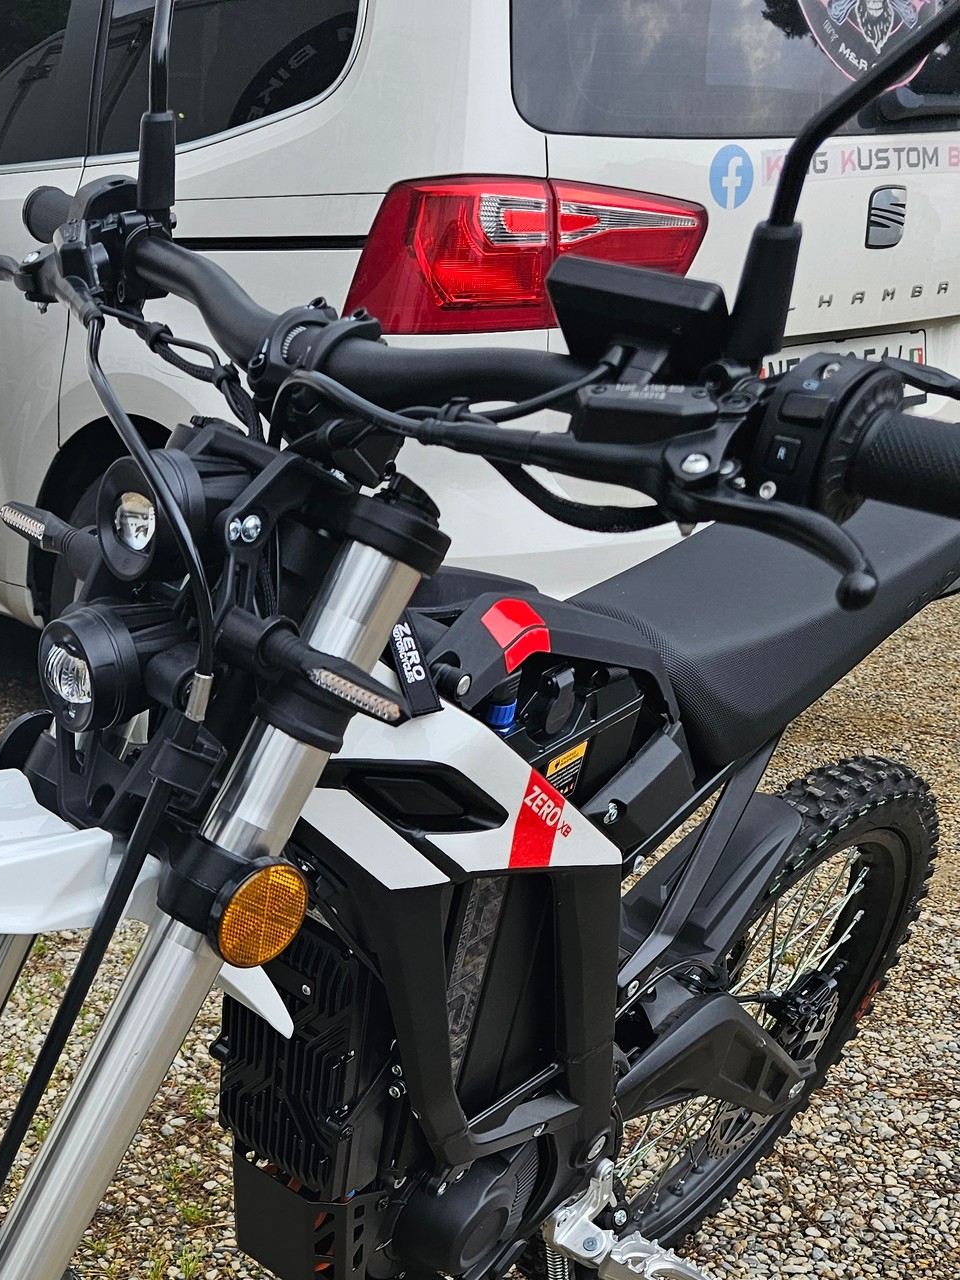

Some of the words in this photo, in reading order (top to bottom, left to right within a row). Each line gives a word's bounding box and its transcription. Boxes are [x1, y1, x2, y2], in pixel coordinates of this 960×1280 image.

[766, 151, 828, 183] KG
[840, 146, 939, 175] KUSTOM
[396, 622, 426, 681] ZERO
[523, 784, 562, 826] ZERO
[557, 820, 573, 837] XB
